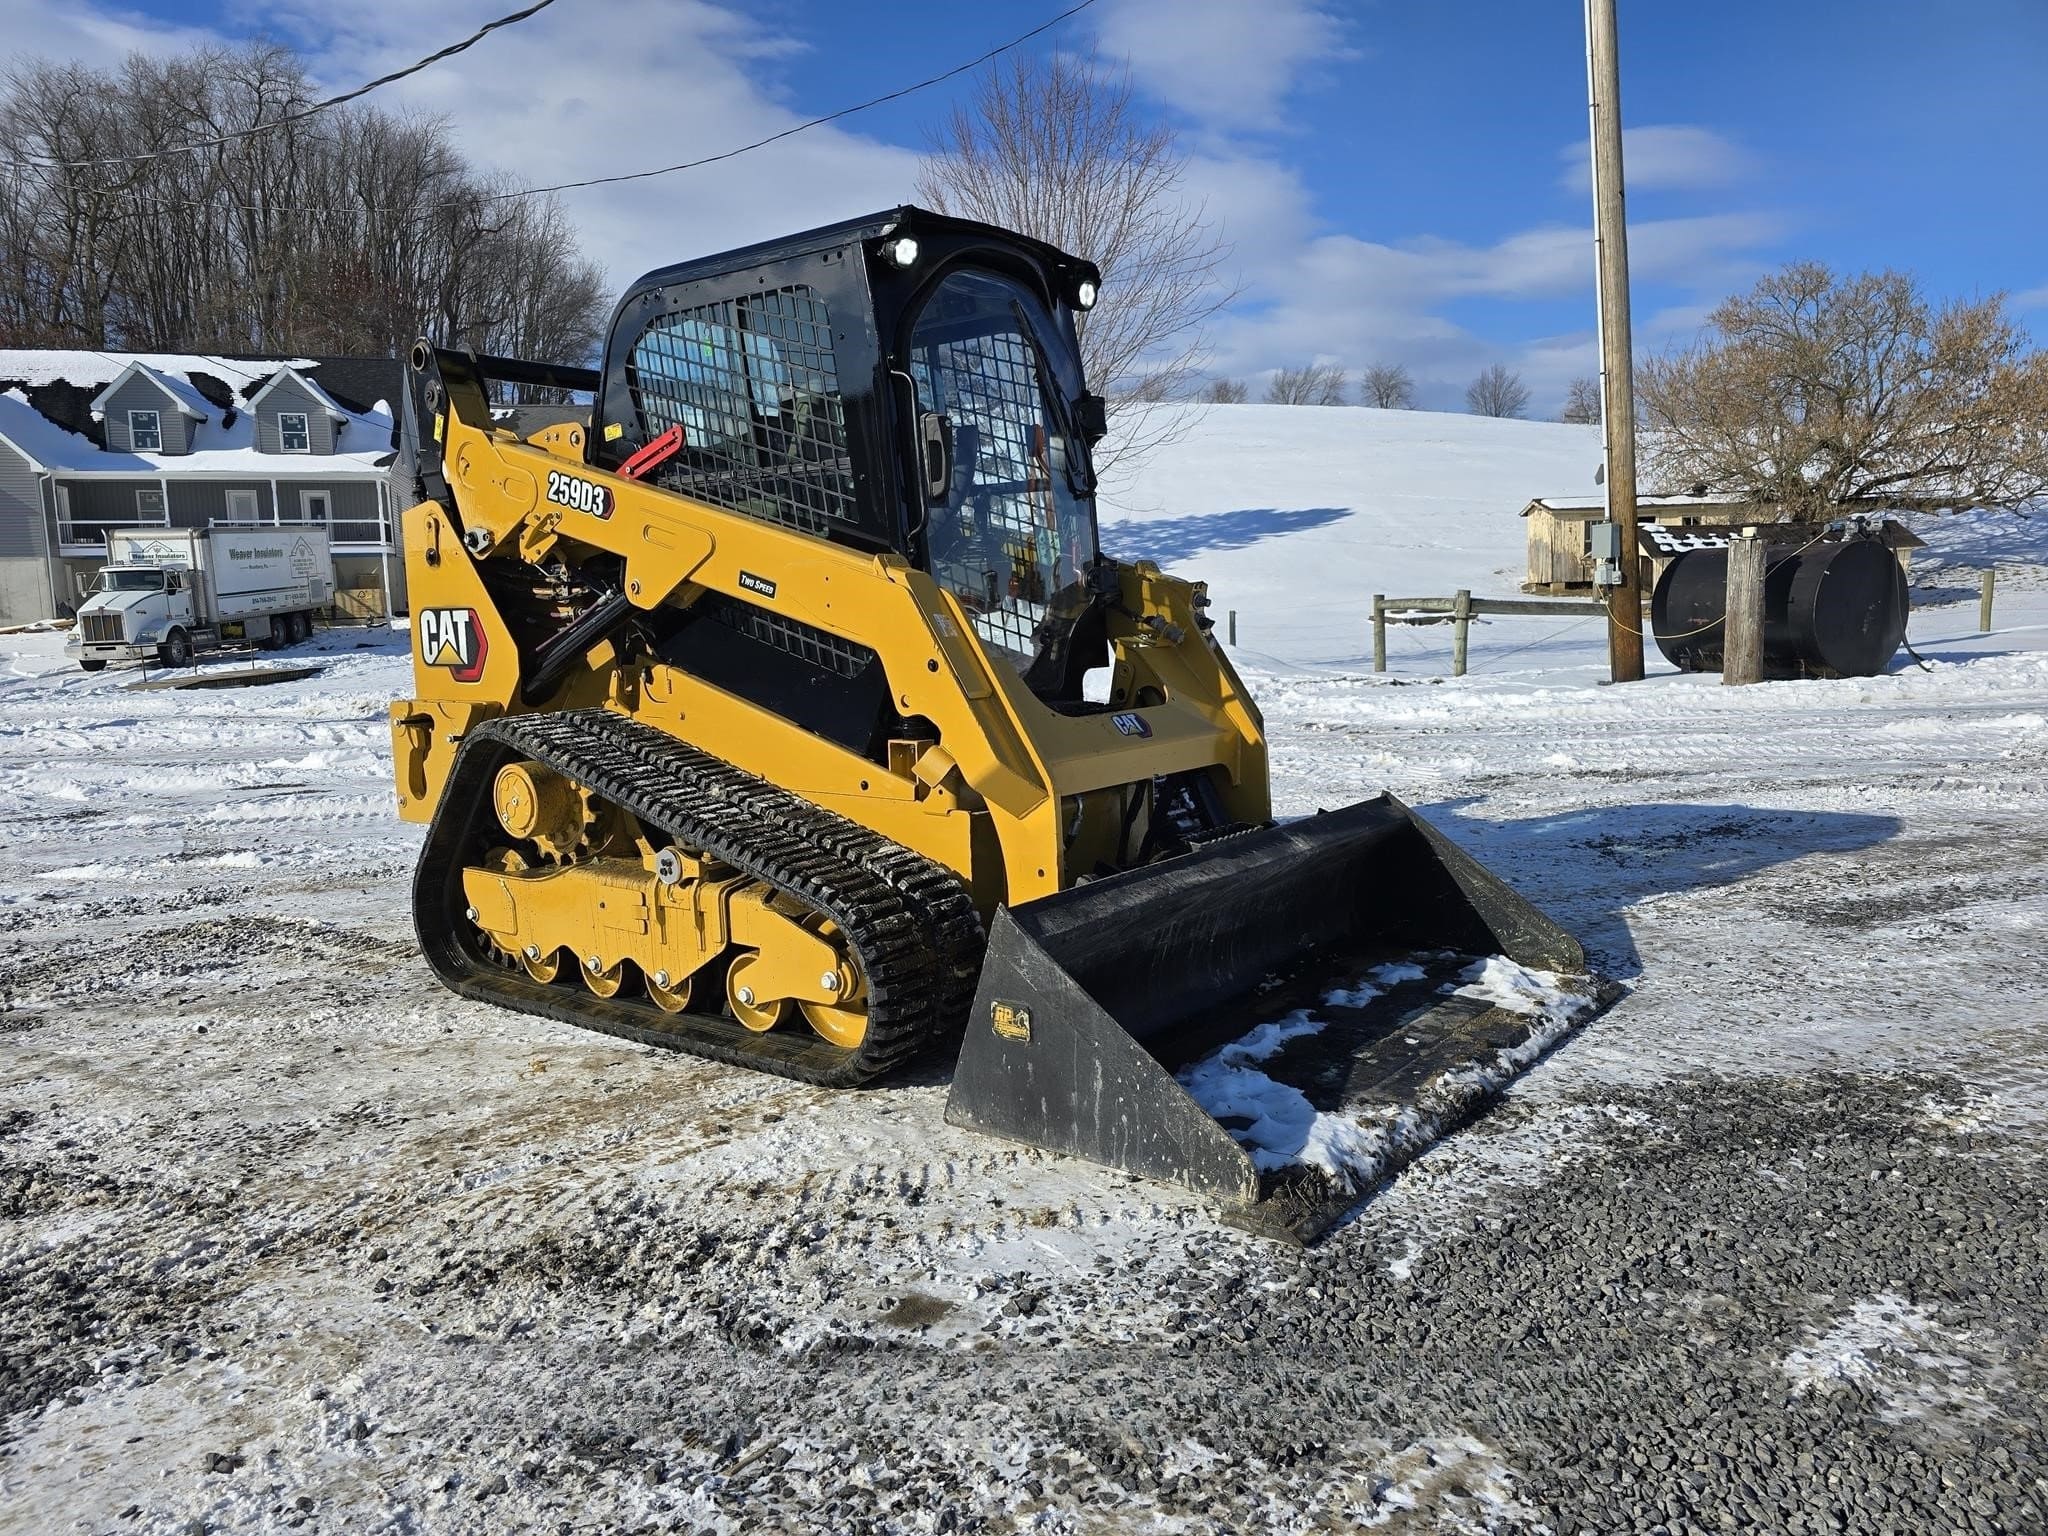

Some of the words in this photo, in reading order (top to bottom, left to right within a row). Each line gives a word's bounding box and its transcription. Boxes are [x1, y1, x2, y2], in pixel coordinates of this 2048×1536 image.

[547, 471, 605, 516] 259D3
[420, 610, 469, 665] CAT
[1112, 714, 1145, 735] CAT
